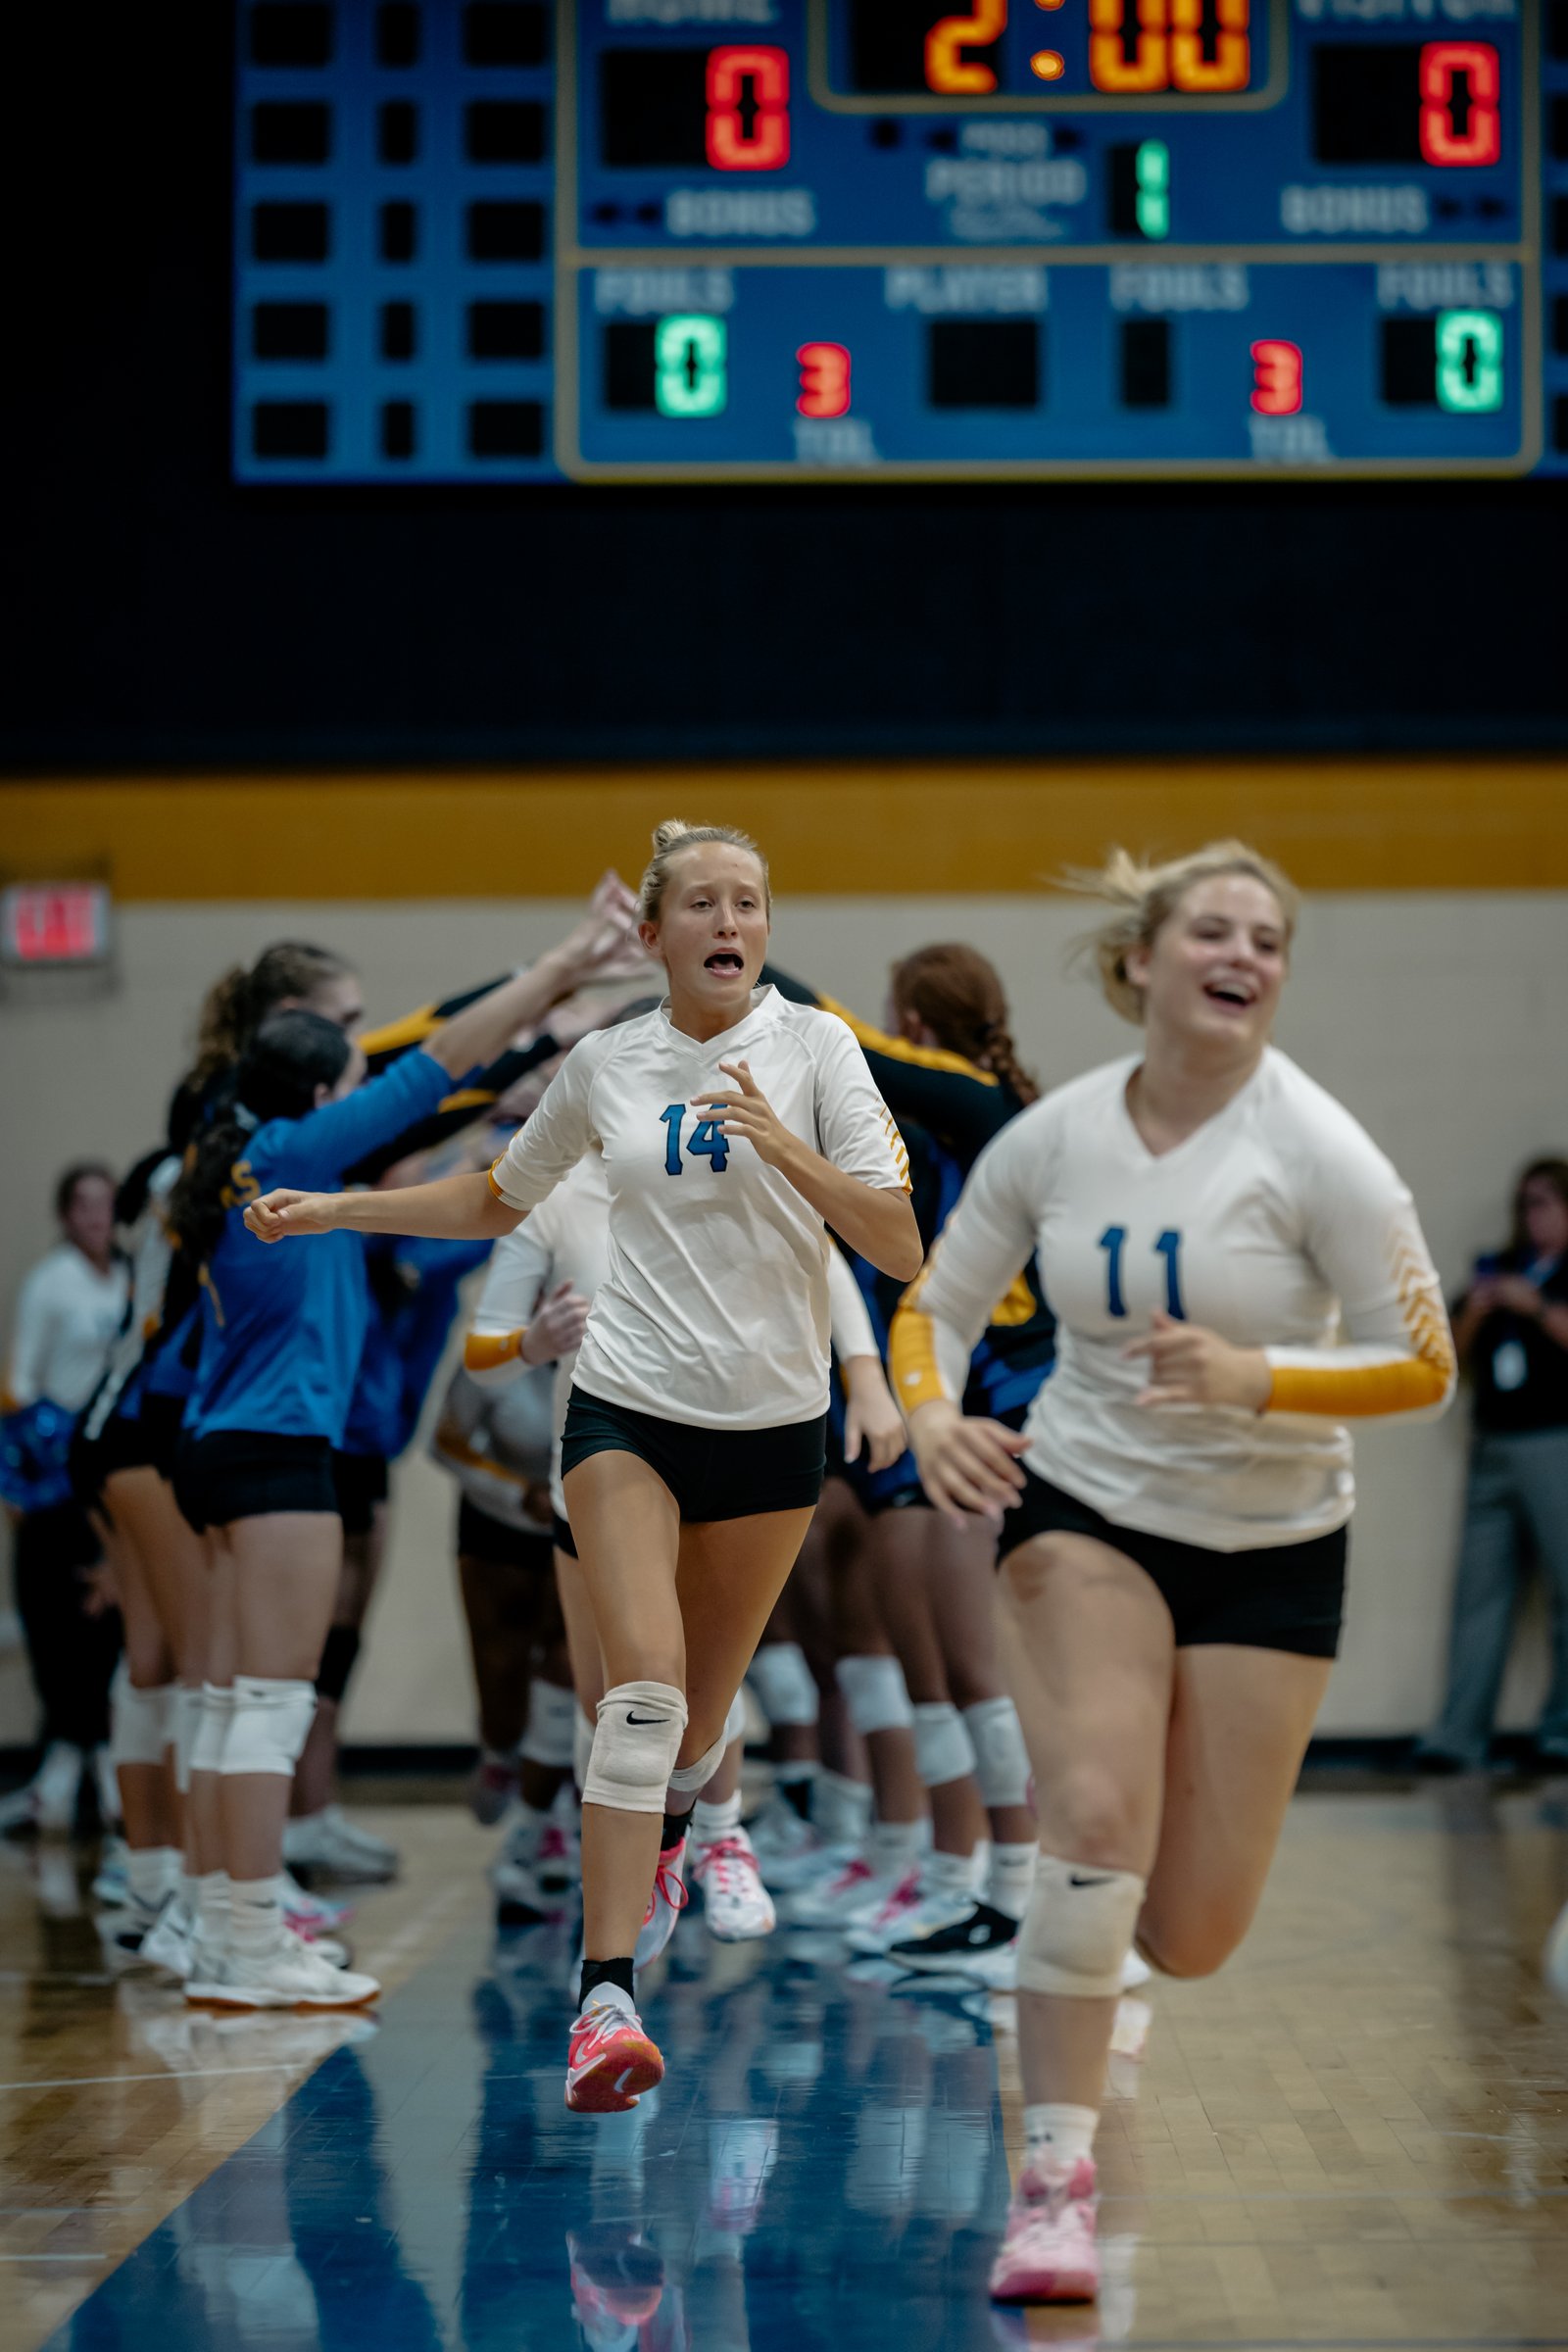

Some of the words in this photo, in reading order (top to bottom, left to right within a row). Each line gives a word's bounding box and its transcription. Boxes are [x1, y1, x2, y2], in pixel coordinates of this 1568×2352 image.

[706, 44, 790, 172] 0
[1419, 40, 1500, 167] 0
[666, 188, 815, 236] BONUS
[926, 158, 1086, 203] PERIOD
[1135, 138, 1169, 239] 1
[1281, 185, 1428, 233] BONUS
[595, 264, 733, 315] FOULS
[885, 264, 1048, 313] PLAYER
[1108, 263, 1249, 311] FOULS
[1377, 261, 1513, 310] FOULS
[656, 312, 727, 418] 0
[795, 341, 852, 419] 3
[1250, 338, 1303, 416] 3
[1436, 309, 1503, 414] 0
[659, 1103, 730, 1176] 14
[1100, 1226, 1186, 1320] 11
